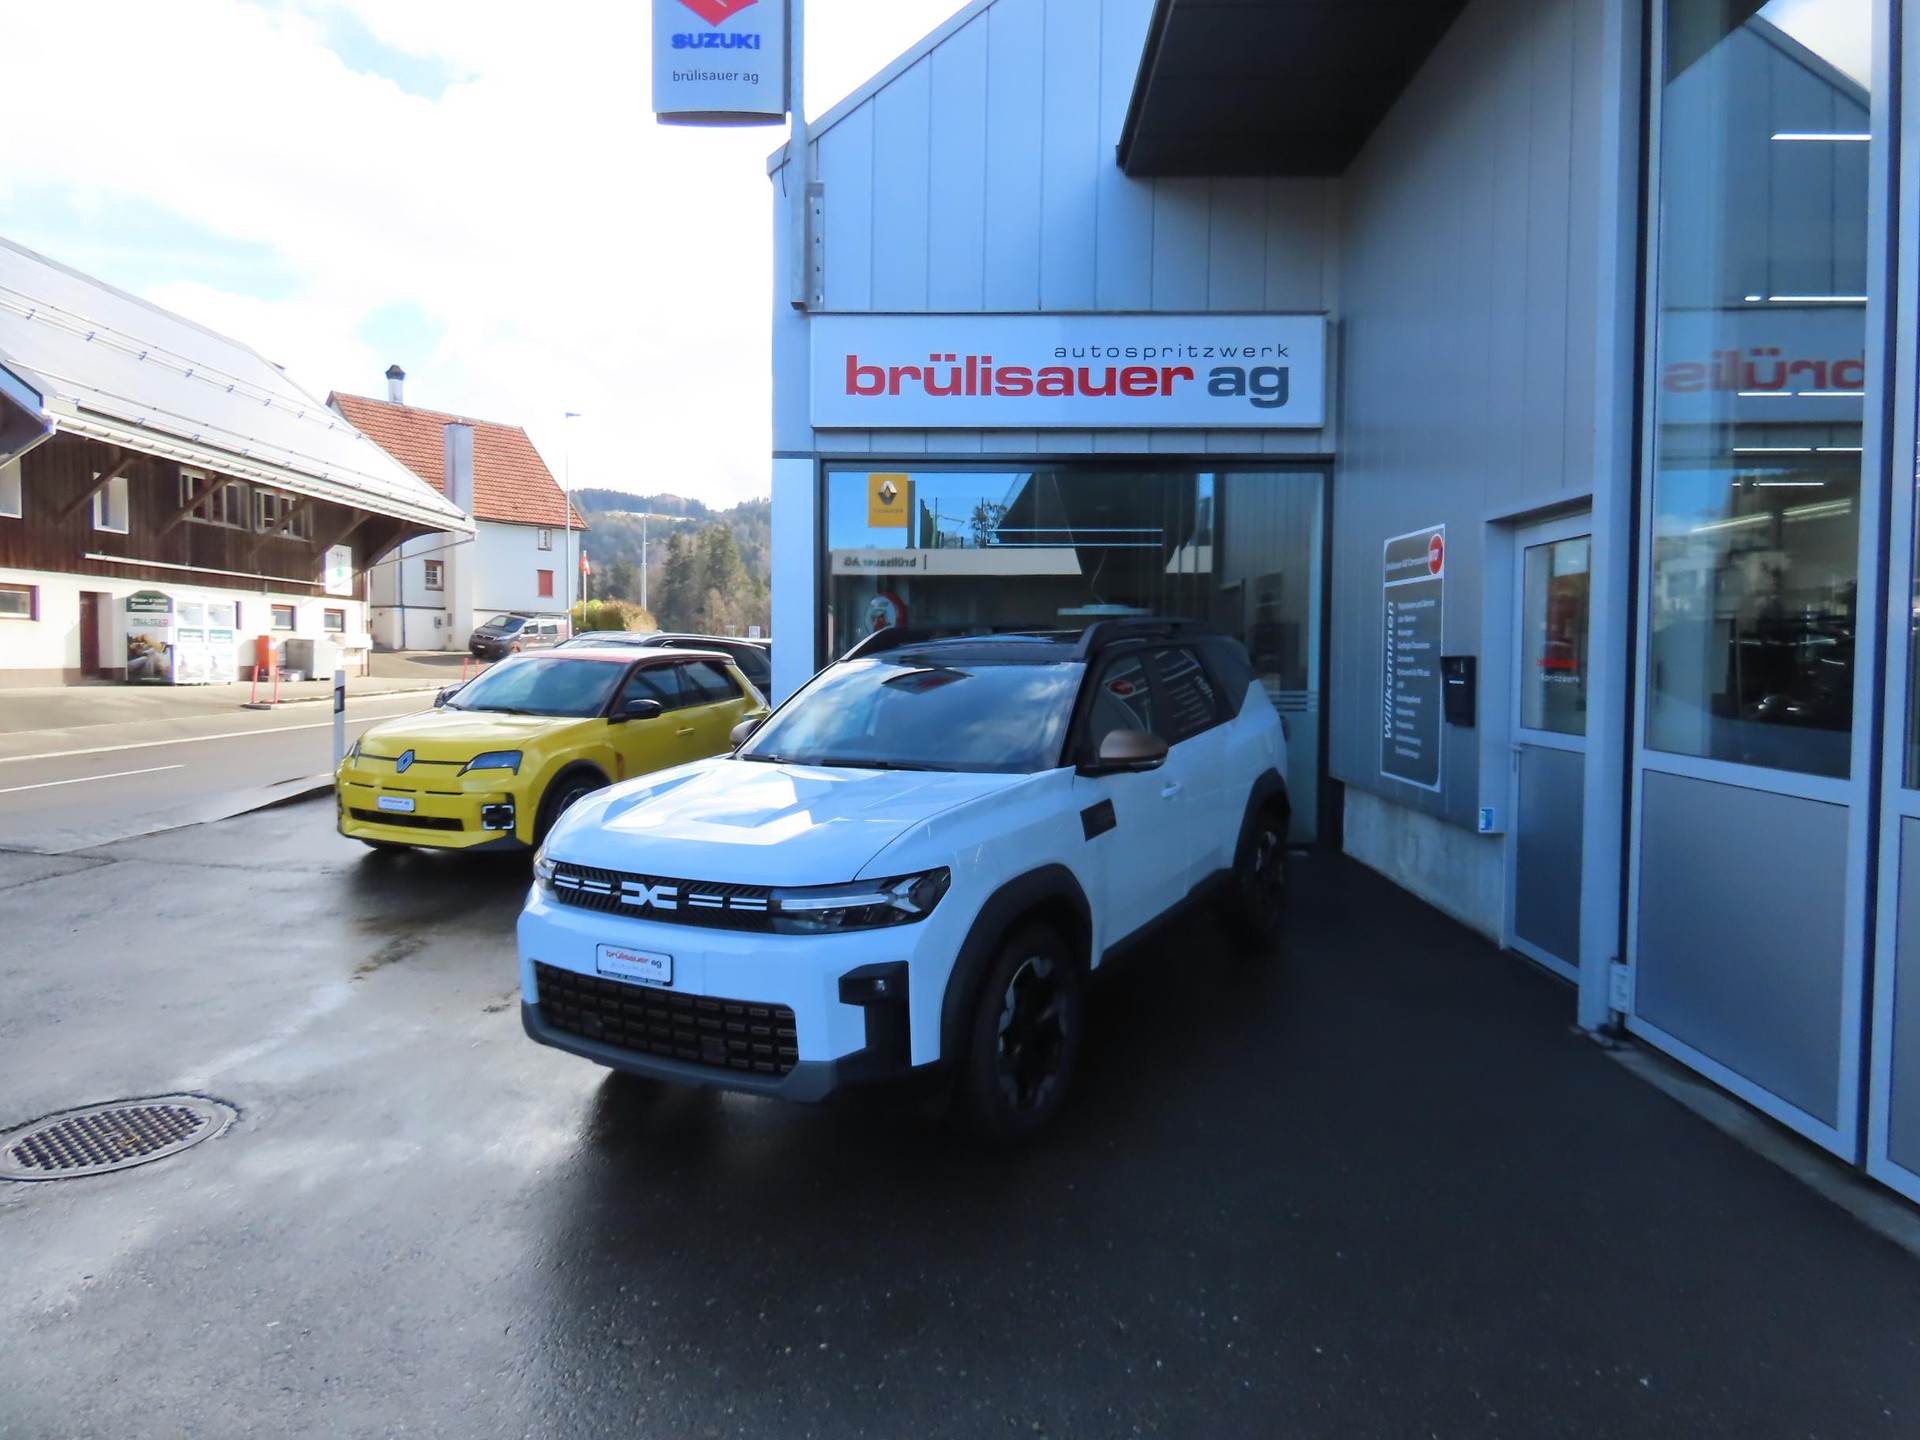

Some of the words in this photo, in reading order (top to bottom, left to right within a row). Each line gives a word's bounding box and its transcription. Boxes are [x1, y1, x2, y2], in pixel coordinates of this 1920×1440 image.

[671, 33, 760, 49] SUZUKI
[673, 70, 739, 82] brülisauer
[743, 72, 759, 85] ag
[1054, 344, 1290, 360] autospritzwerk
[846, 353, 1194, 397] brülisauer
[1207, 366, 1289, 409] ag
[1384, 601, 1394, 738] Willkommen
[651, 960, 662, 969] ag
